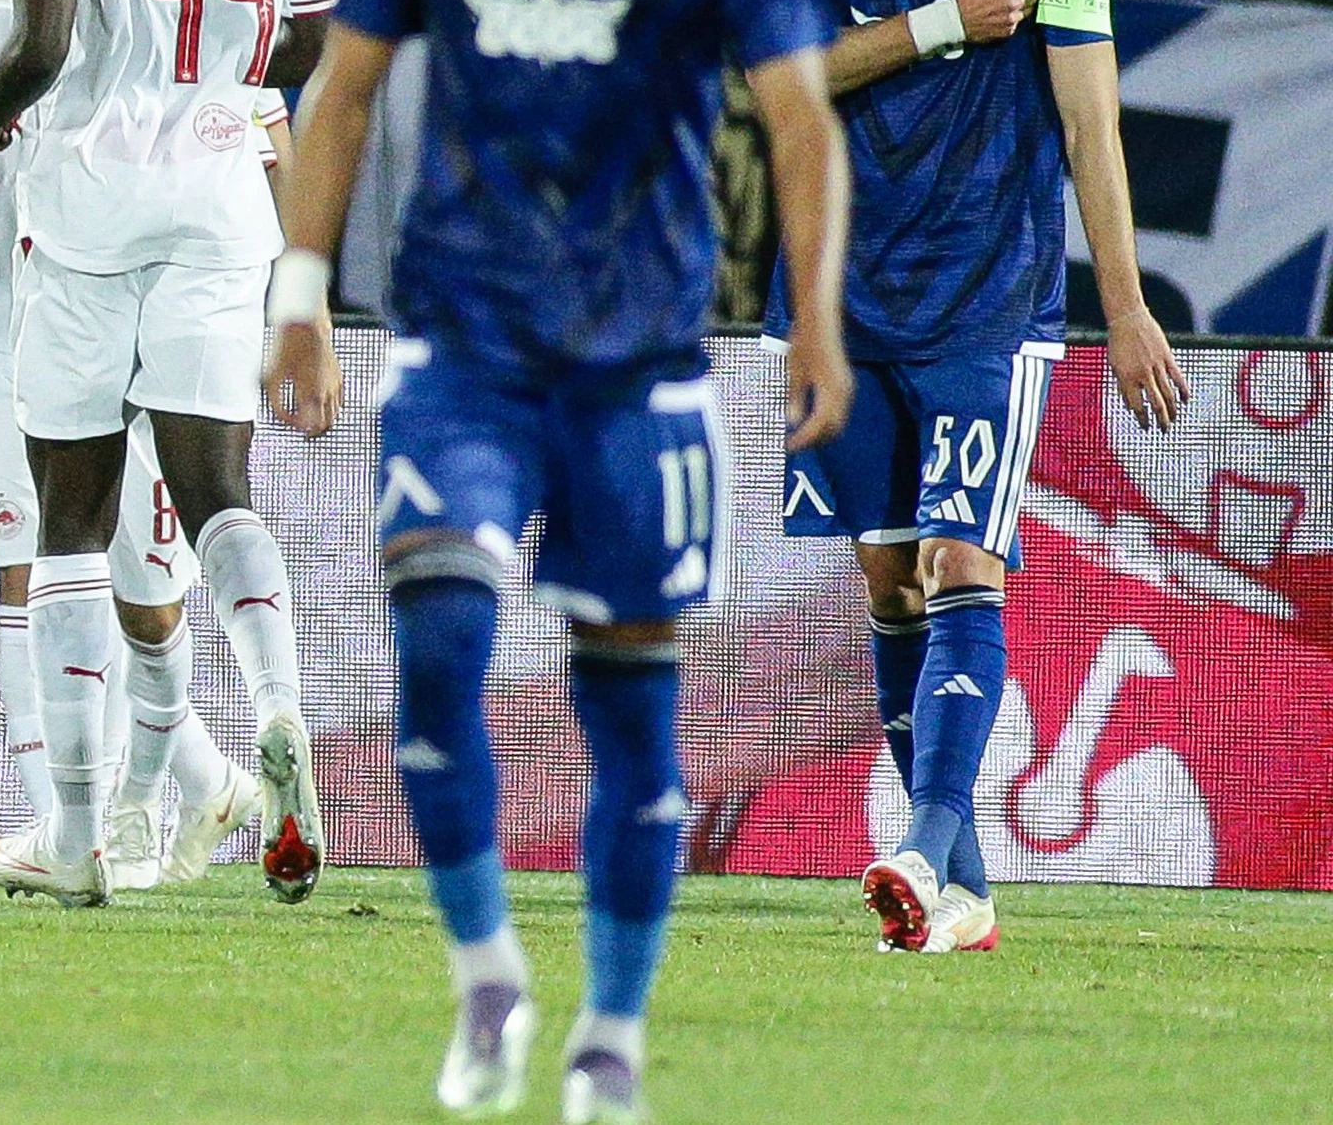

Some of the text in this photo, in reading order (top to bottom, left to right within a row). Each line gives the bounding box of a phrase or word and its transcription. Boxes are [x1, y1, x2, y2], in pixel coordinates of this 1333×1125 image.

[922, 415, 997, 488] 50
[153, 479, 179, 544] 8
[657, 443, 710, 549] 11
